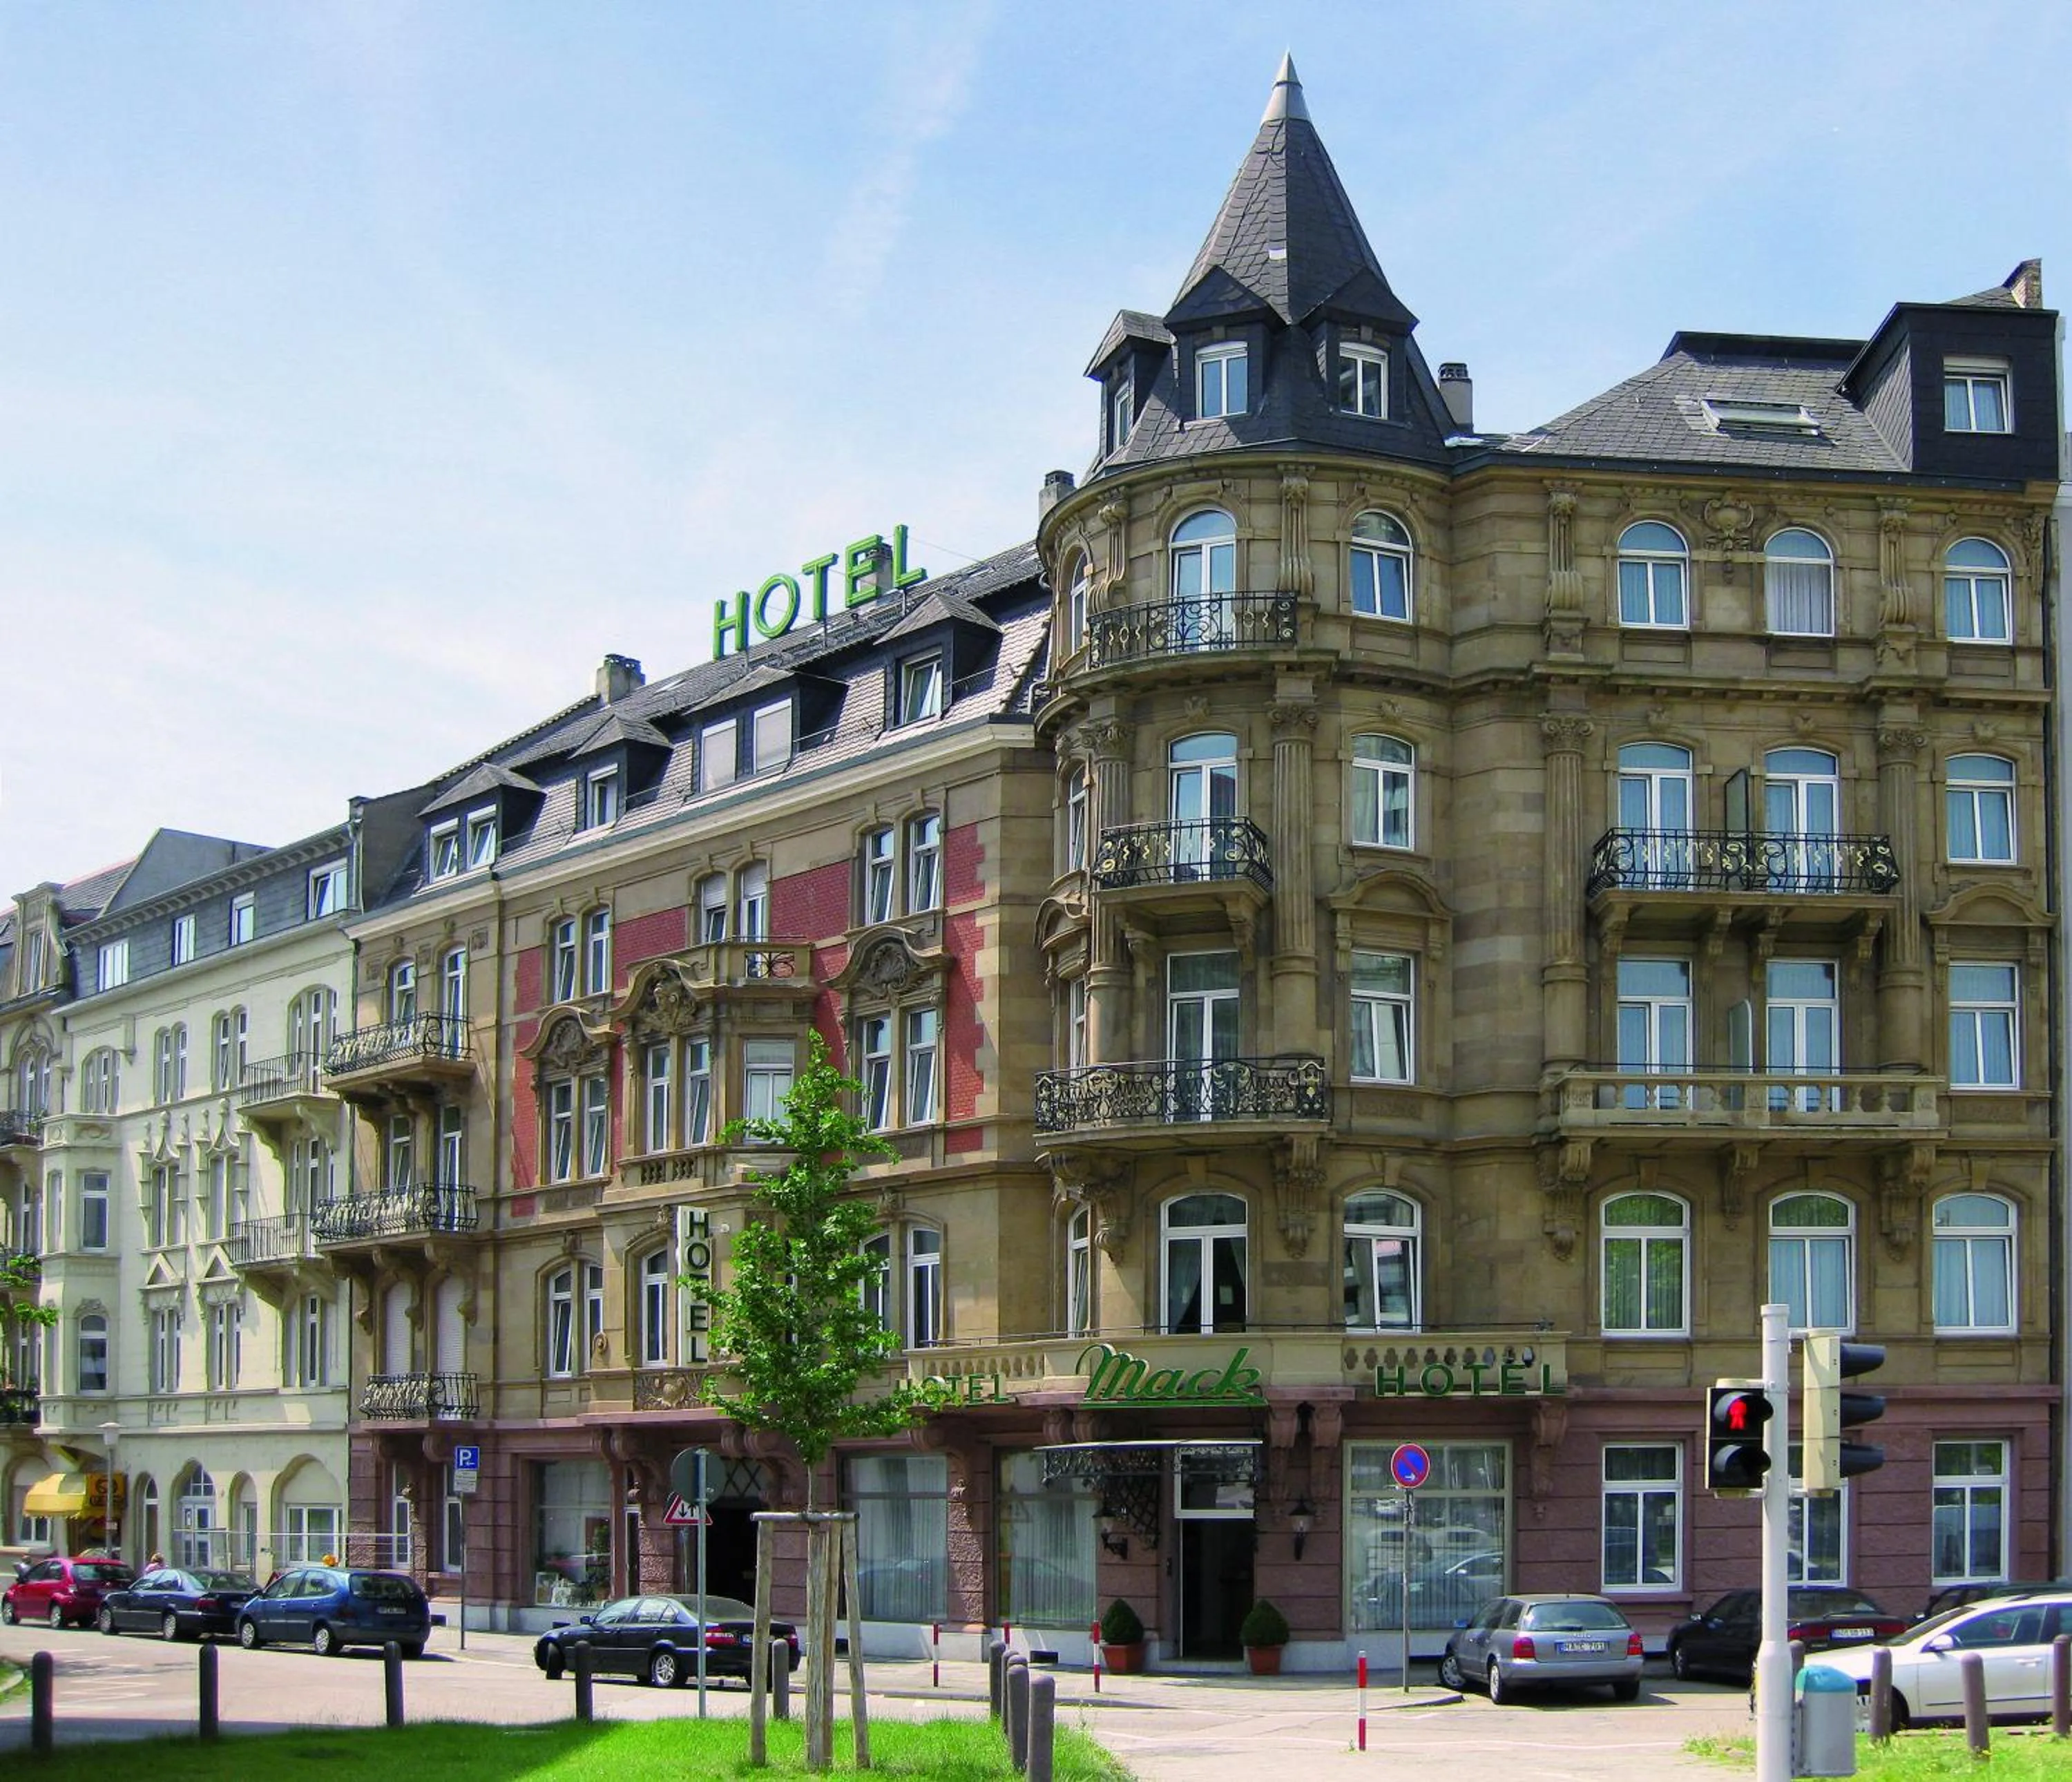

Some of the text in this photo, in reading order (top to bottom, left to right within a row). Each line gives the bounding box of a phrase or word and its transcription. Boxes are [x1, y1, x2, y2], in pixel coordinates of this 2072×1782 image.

[713, 524, 928, 662] HOTEL
[1075, 1343, 1262, 1399] Mack
[1376, 1363, 1566, 1396] HOTEL
[459, 1448, 472, 1466] P
